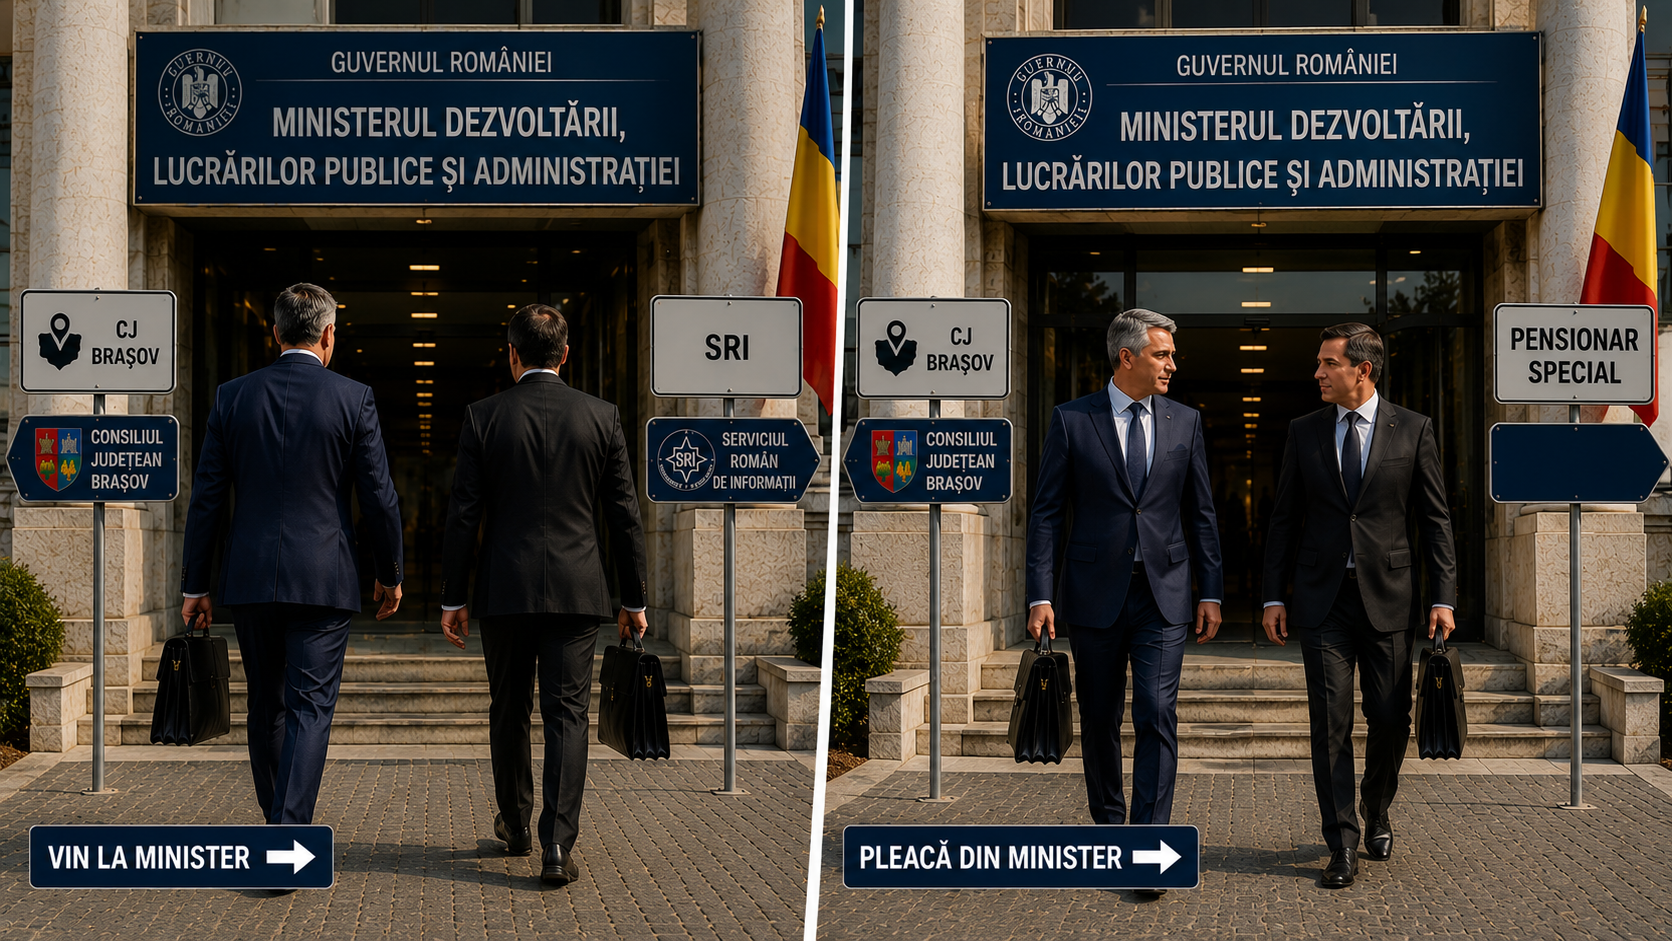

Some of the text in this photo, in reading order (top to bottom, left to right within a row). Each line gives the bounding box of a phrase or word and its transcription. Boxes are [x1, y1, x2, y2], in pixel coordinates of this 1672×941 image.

[331, 46, 552, 73] GUVERNUL ROMÂNIEI
[1177, 48, 1397, 77] GUVERNUL ROMÂNIEI
[273, 100, 626, 143] MINISTERUL DEZVOLTĂRII,
[1120, 102, 1471, 145] MINISTERUL DEZVOLTĂRII,
[154, 150, 316, 185] LUCRĂRILOR
[325, 156, 434, 185] PUBLICE
[1002, 155, 1161, 191] LUCRĂRILOR
[1170, 159, 1278, 190] PUBLICE
[116, 320, 138, 339] CJ
[950, 327, 972, 346] CJ
[1510, 327, 1640, 352] PENSIONAR
[704, 333, 749, 361] SRI
[1527, 360, 1622, 384] SPECIAL
[91, 429, 164, 445] CONSILIUL
[722, 432, 789, 447] SERVICIUL
[926, 431, 998, 447] CONSILIUL
[675, 451, 696, 468] SRI
[730, 450, 778, 469] ROMÂN
[712, 475, 727, 489] DE
